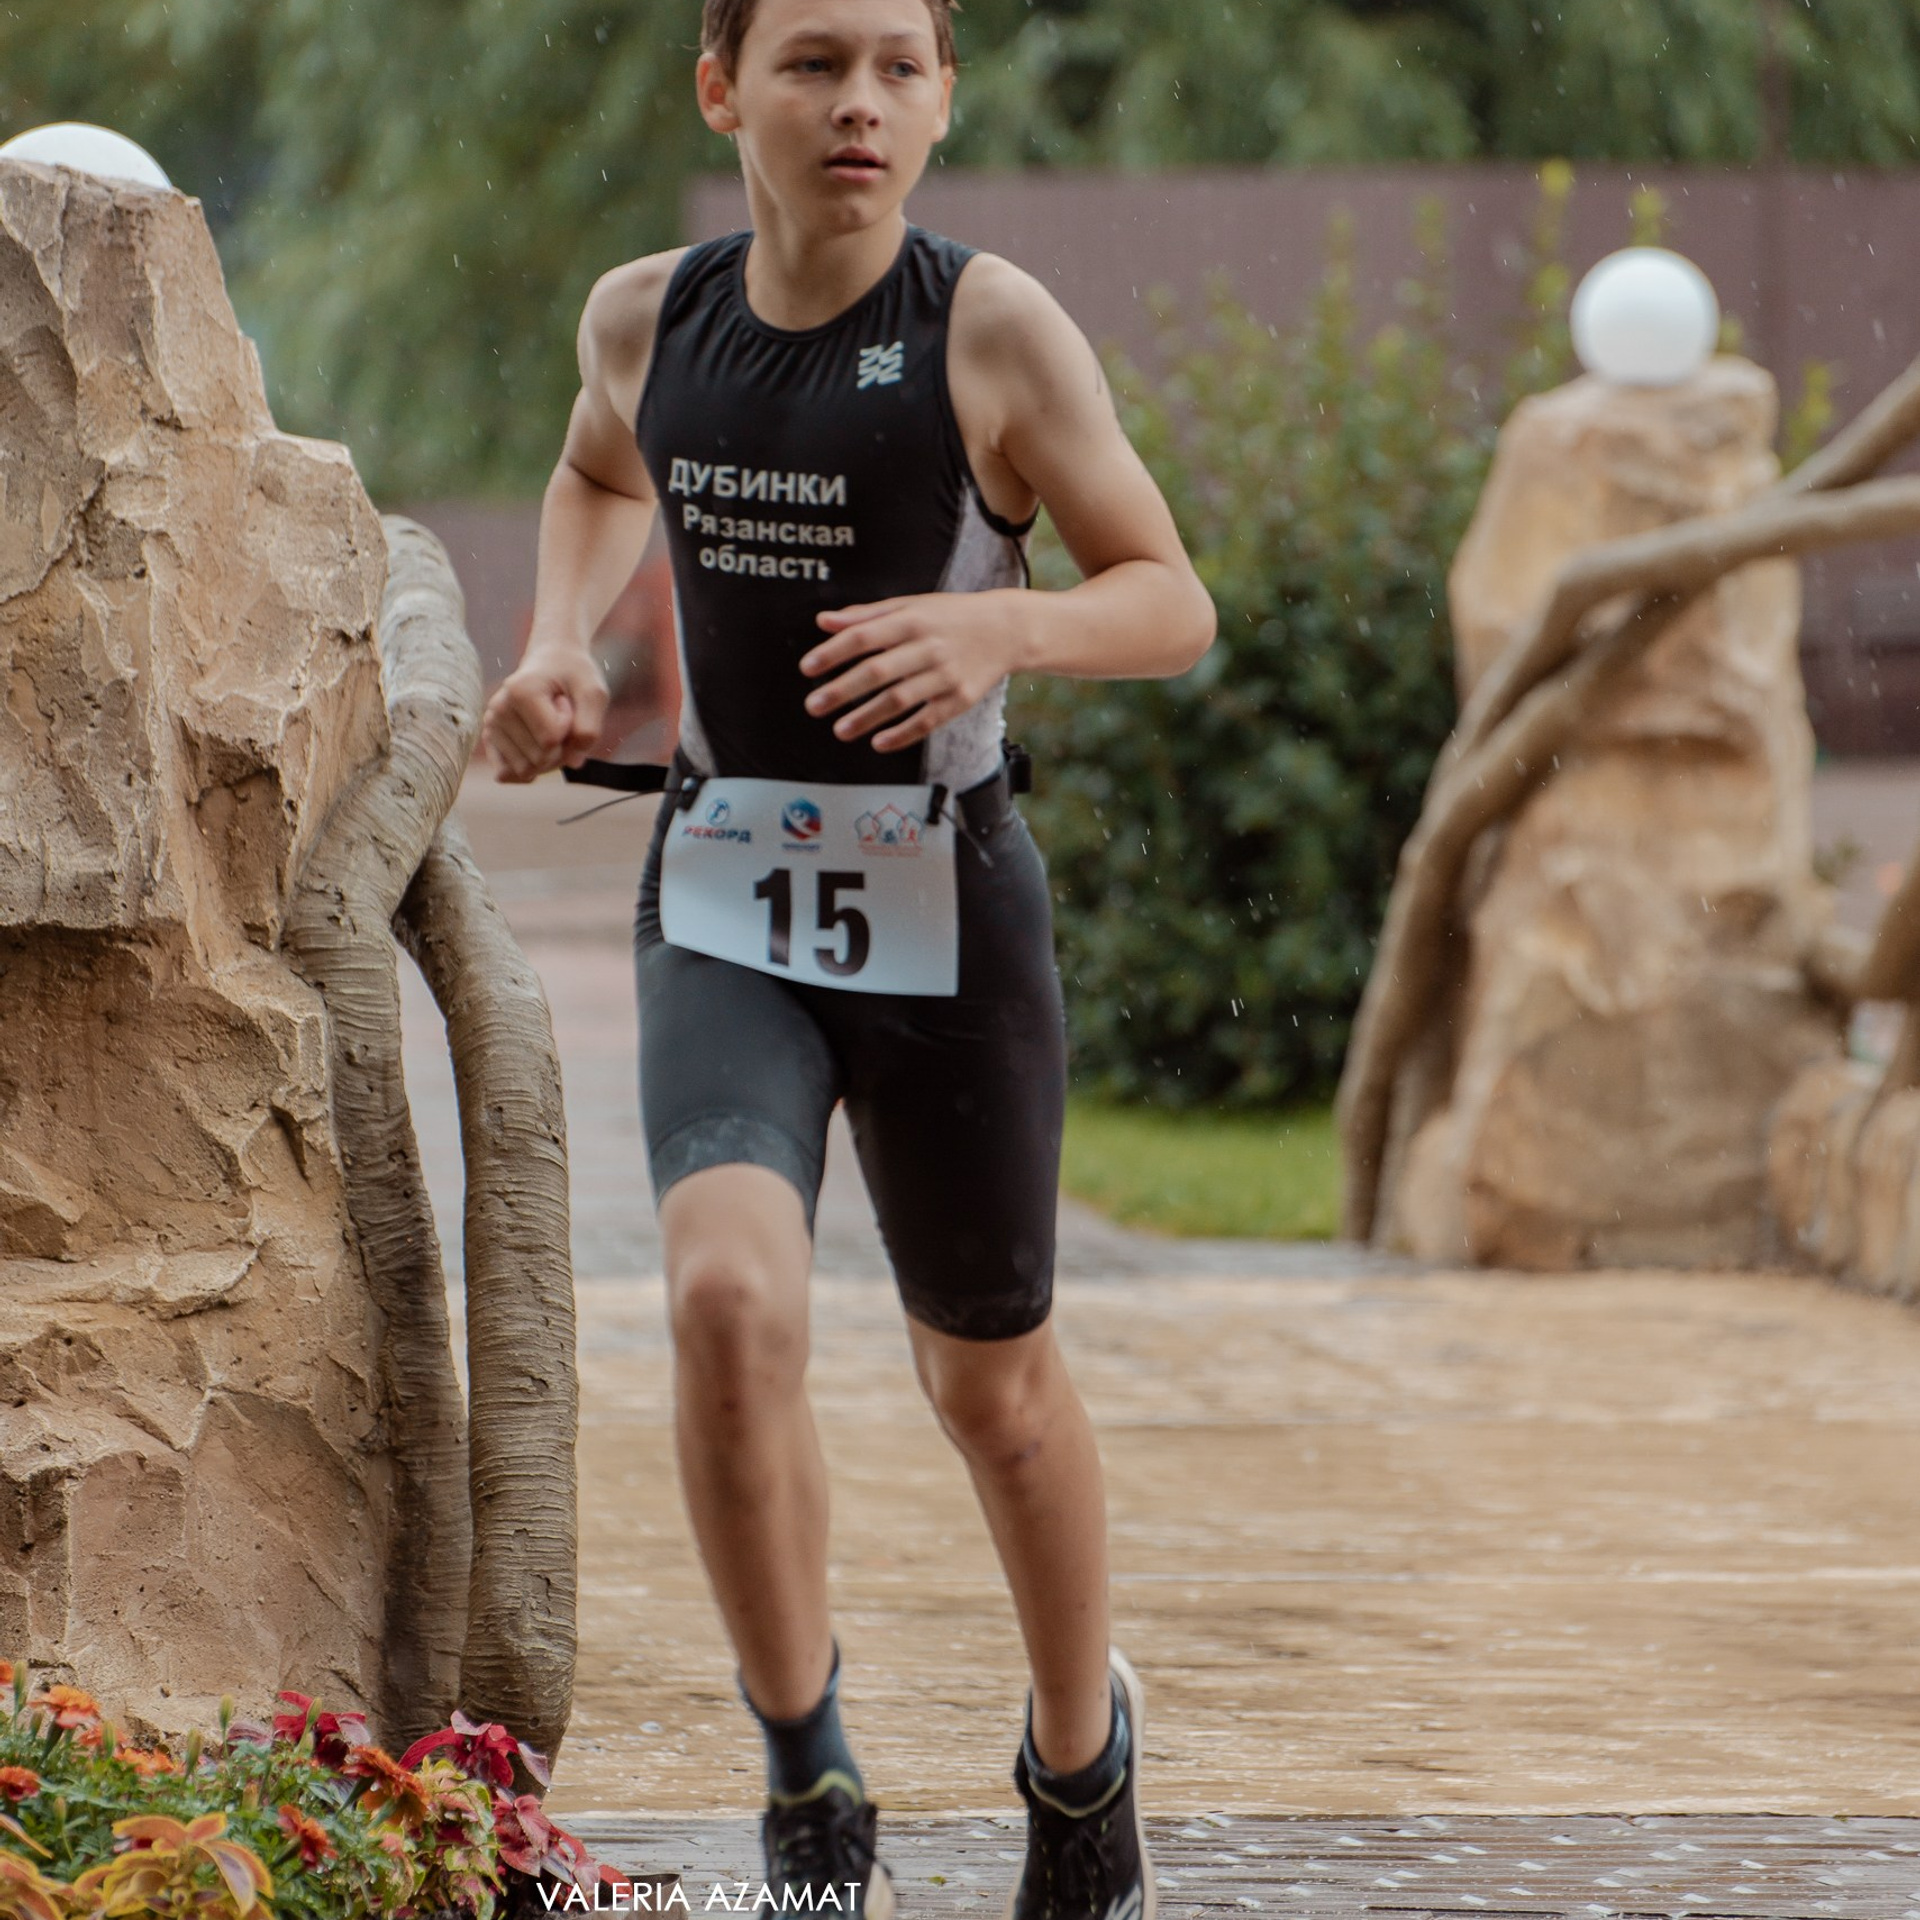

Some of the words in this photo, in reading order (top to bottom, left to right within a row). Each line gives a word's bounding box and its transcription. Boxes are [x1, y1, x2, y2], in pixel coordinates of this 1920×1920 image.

[668, 457, 847, 506] ДУБИНКИ
[683, 504, 855, 547] Рязанская
[699, 544, 830, 581] область
[753, 868, 870, 977] 15
